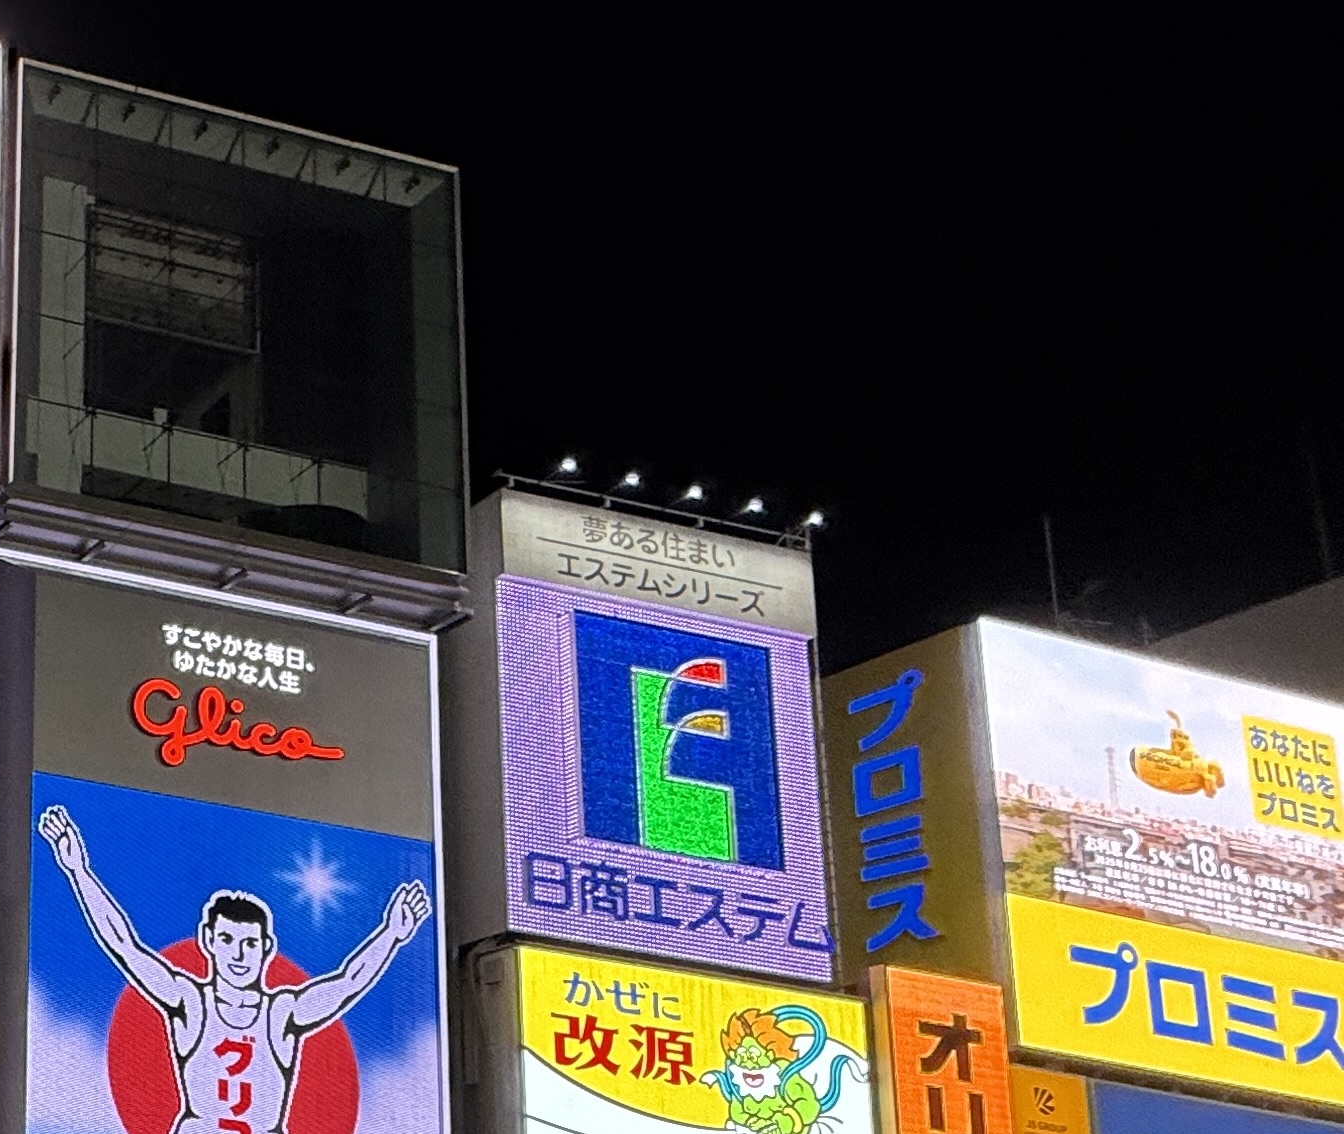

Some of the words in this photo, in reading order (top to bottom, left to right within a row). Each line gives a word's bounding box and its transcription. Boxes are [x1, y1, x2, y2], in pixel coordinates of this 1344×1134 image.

[582, 514, 737, 570] 夢ある住まい
[557, 551, 767, 618] エステムシリーズ
[162, 623, 316, 672] すこやかな毎日、
[173, 650, 302, 695] ゆたかな人生
[131, 677, 345, 766] Glico
[1248, 724, 1332, 767] あなたに
[1251, 758, 1336, 801] いいねを
[847, 667, 946, 954] プロミス
[1256, 792, 1343, 834] プロミス
[524, 851, 837, 954] 日商エステム
[563, 971, 683, 1021] かぜに
[1069, 941, 1344, 1072] プロミス
[550, 1012, 697, 1086] 改源
